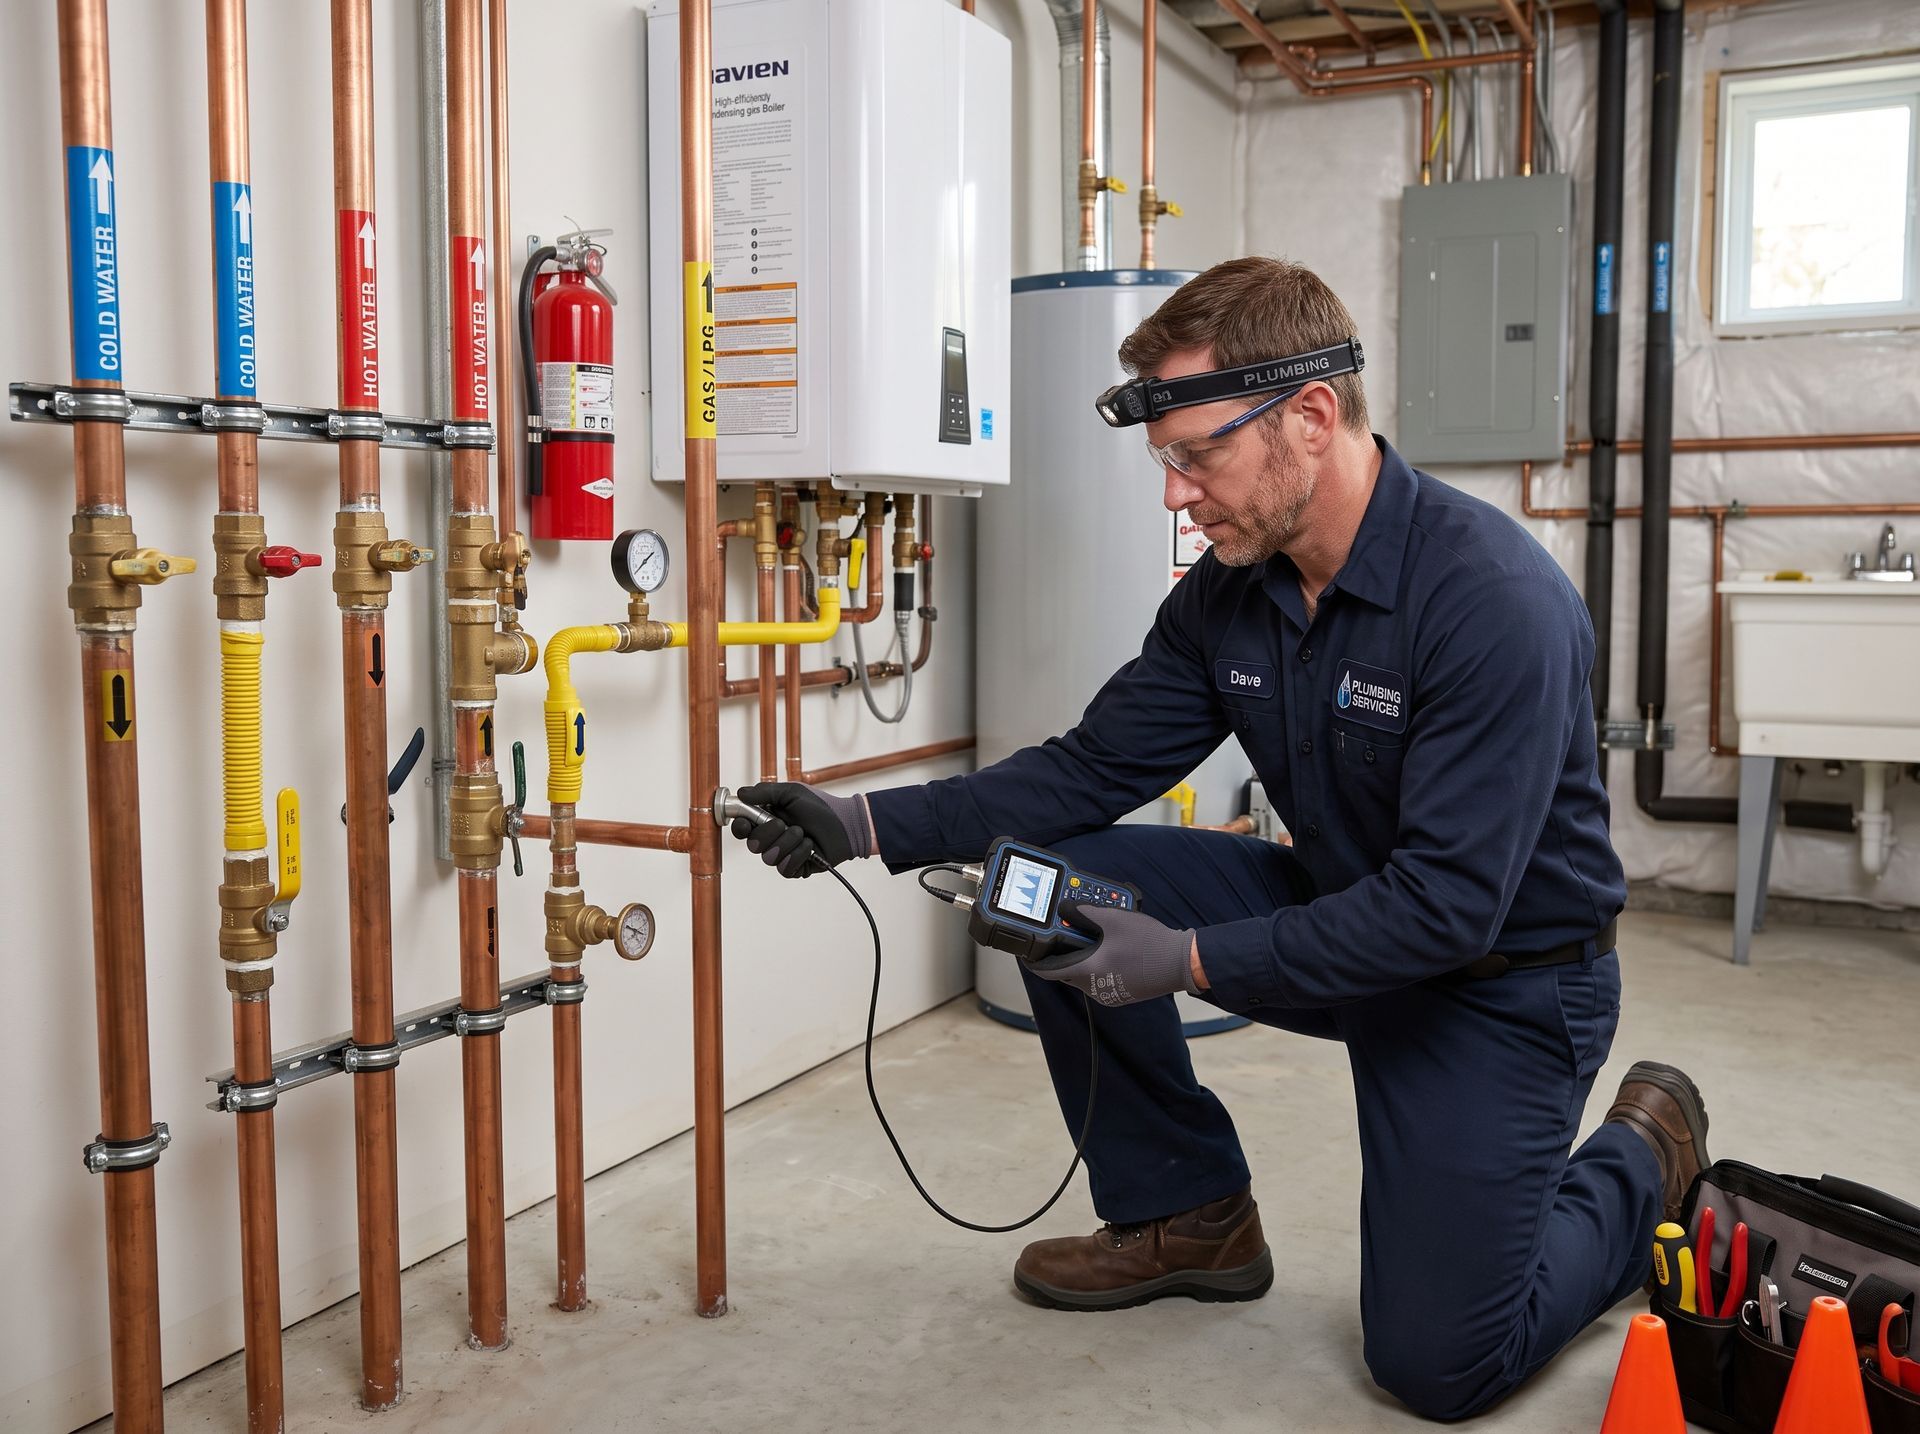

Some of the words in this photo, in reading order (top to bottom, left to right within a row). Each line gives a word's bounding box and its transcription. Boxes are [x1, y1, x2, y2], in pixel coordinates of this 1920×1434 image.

[712, 107, 745, 119] ndensing
[762, 102, 786, 113] Boiler
[95, 226, 116, 304] WATER
[237, 256, 253, 328] WATER
[361, 281, 376, 350] WATER
[98, 311, 119, 371] COLD
[473, 301, 486, 367] WATER
[239, 334, 255, 389] COLD
[363, 356, 378, 396] HOT
[702, 325, 716, 423] GAS/LPG
[1244, 357, 1330, 386] PLUMBING
[474, 371, 487, 409] HOT
[1230, 670, 1262, 688] Dave
[1352, 680, 1401, 704] PLUMBING
[1352, 694, 1400, 718] SERVICES
